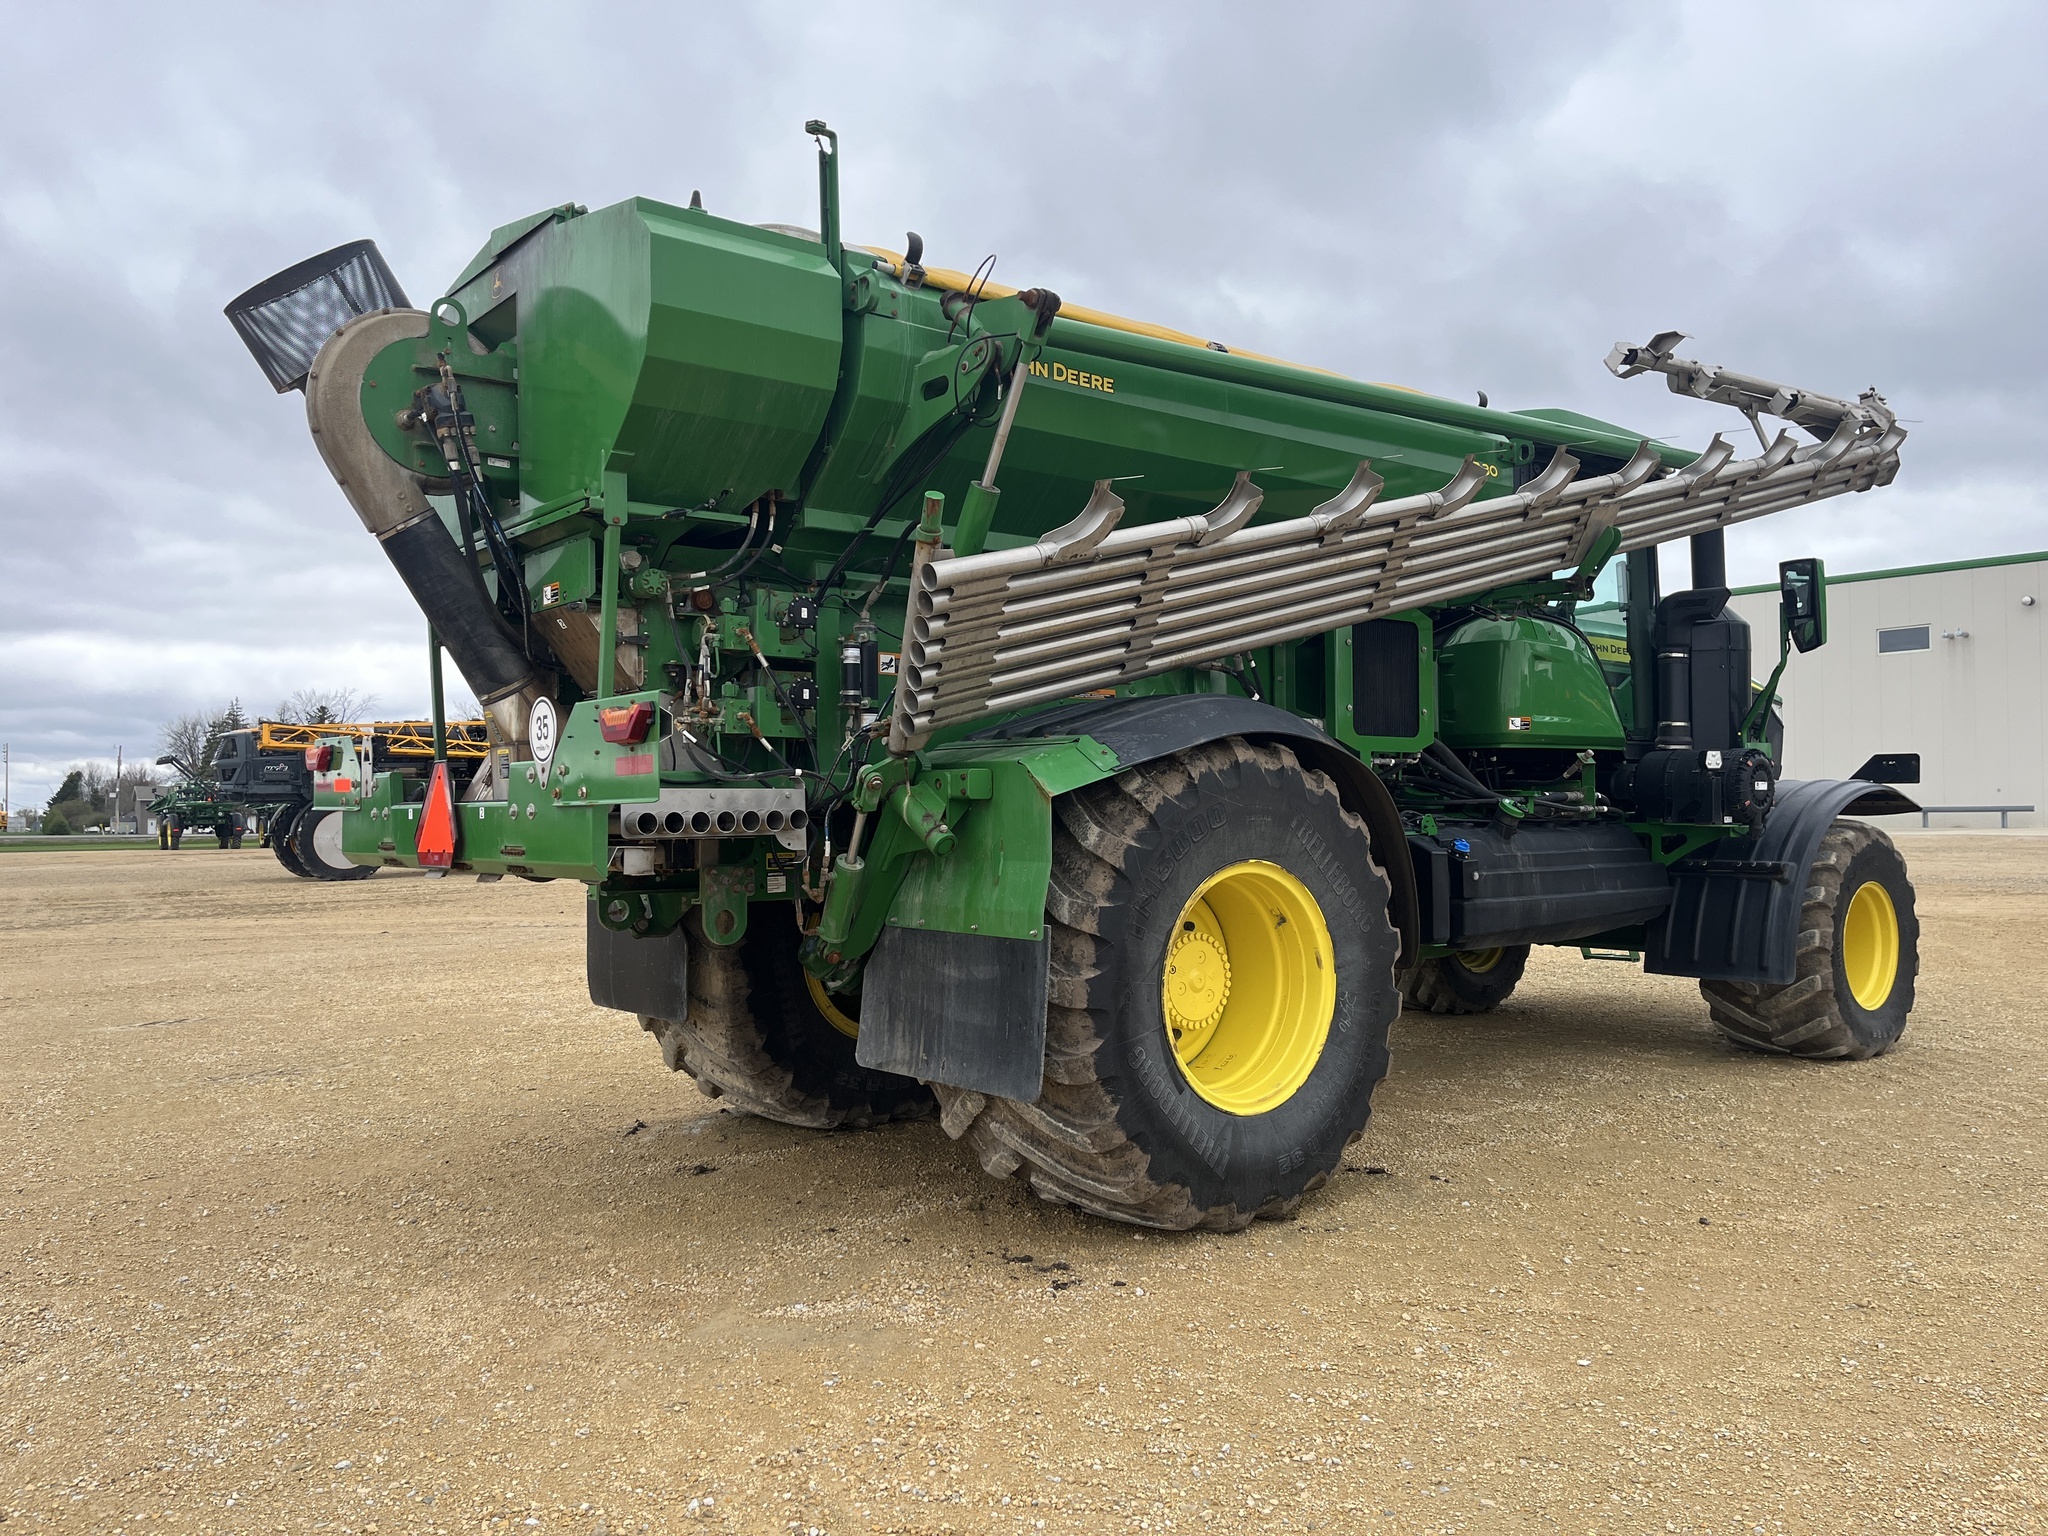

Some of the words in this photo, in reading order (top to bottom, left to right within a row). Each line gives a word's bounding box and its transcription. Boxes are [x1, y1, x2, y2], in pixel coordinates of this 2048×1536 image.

[1052, 362, 1115, 394] DEERE
[1610, 644, 1628, 656] DEE
[536, 714, 549, 741] 35
[1124, 802, 1228, 942] TM3000
[1289, 811, 1375, 934] TRELLEBORG
[1126, 1044, 1231, 1180] TRELLEBORG
